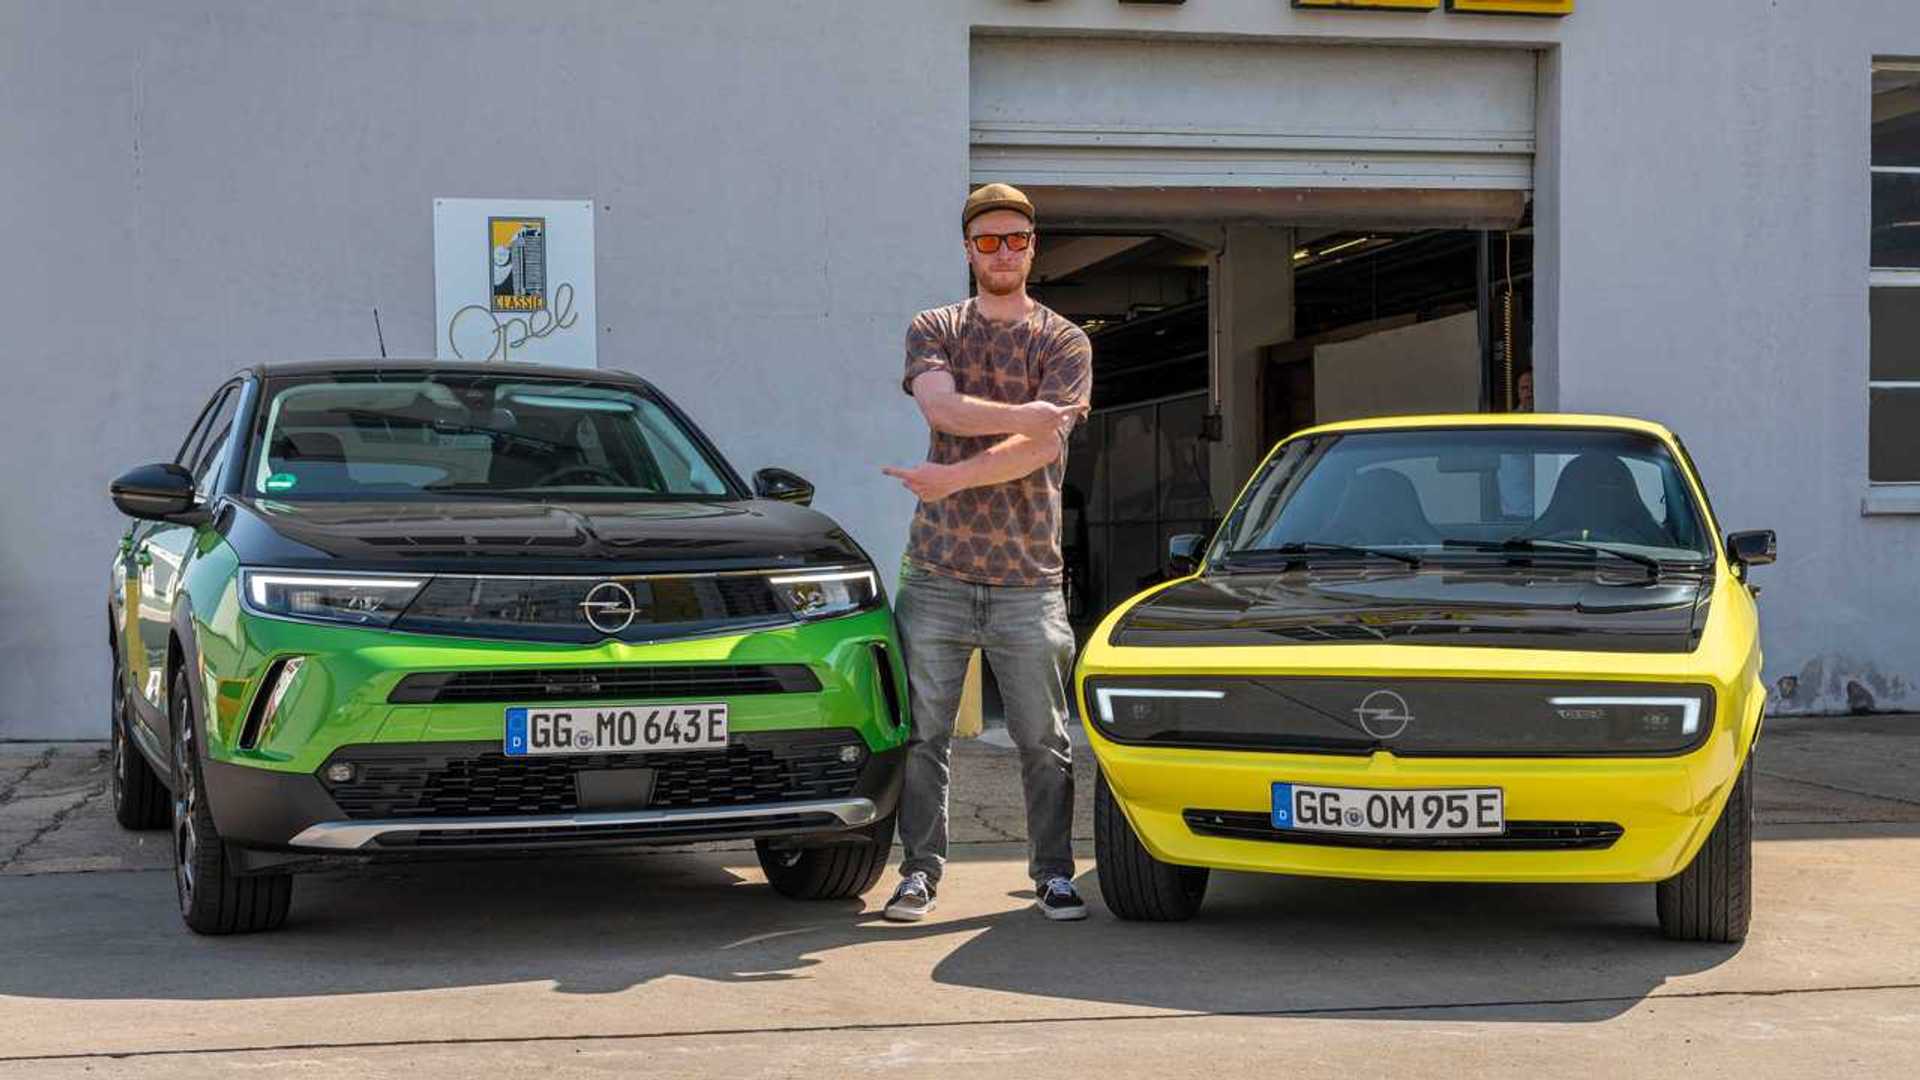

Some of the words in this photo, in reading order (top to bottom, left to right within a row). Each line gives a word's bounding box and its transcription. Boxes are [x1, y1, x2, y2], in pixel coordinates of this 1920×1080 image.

[450, 283, 578, 362] Opel
[512, 736, 522, 748] D
[531, 713, 573, 748] GG
[596, 710, 638, 747] MO
[1279, 810, 1288, 821] D
[1295, 790, 1343, 826] GG
[1366, 794, 1415, 829] OM
